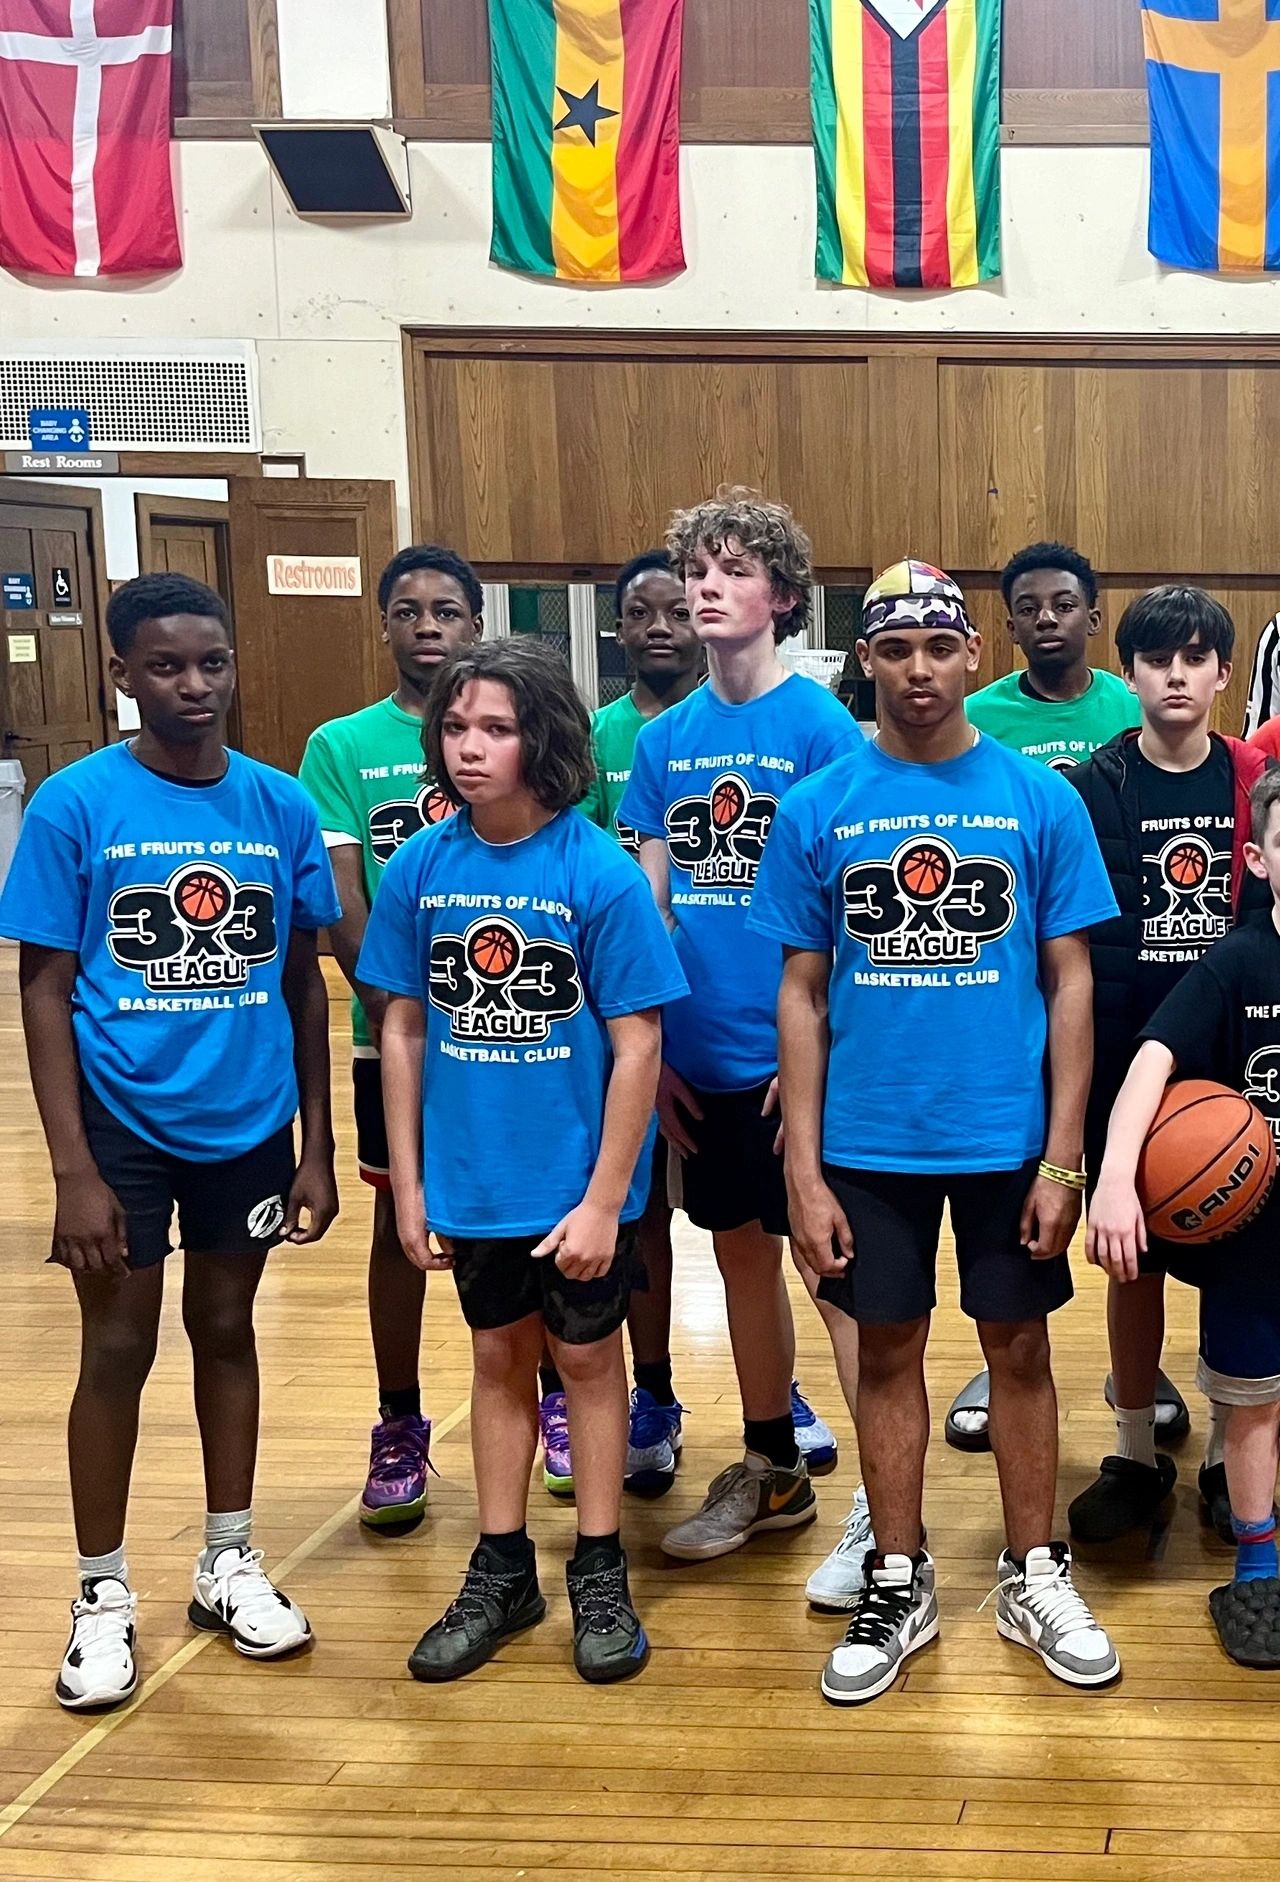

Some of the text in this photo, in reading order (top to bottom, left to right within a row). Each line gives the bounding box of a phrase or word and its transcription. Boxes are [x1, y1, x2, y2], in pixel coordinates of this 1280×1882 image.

[22, 455, 102, 468] Rest Rooms
[274, 558, 356, 590] Restrooms
[1021, 740, 1066, 755] FRUITS
[1069, 740, 1086, 752] OF
[668, 760, 691, 772] THE
[695, 755, 733, 770] FRUITS
[735, 753, 755, 766] OF
[360, 766, 389, 780] THE
[606, 770, 631, 783] THE
[834, 814, 1019, 841] THE FRUITS OF LABOR
[1141, 817, 1191, 832] FRUITS
[1194, 816, 1213, 828] OF
[104, 843, 136, 860] THE
[141, 842, 205, 856] FRUITS
[210, 841, 233, 854] OF
[696, 861, 758, 881] LEAGUE
[419, 894, 572, 922] THE FRUITS OF LABOR
[671, 893, 736, 906] BASKETBALL
[1146, 917, 1226, 938] LEAGUE
[872, 936, 974, 957] LEAGUE
[1138, 949, 1206, 962] SKETBAL
[854, 969, 1000, 987] BASKETBALL CLUB
[118, 996, 234, 1012] BASKETBALL
[1245, 1005, 1269, 1018] THE
[452, 1011, 544, 1035] LEAGUE
[440, 1040, 571, 1063] BASKETBALL CLUB
